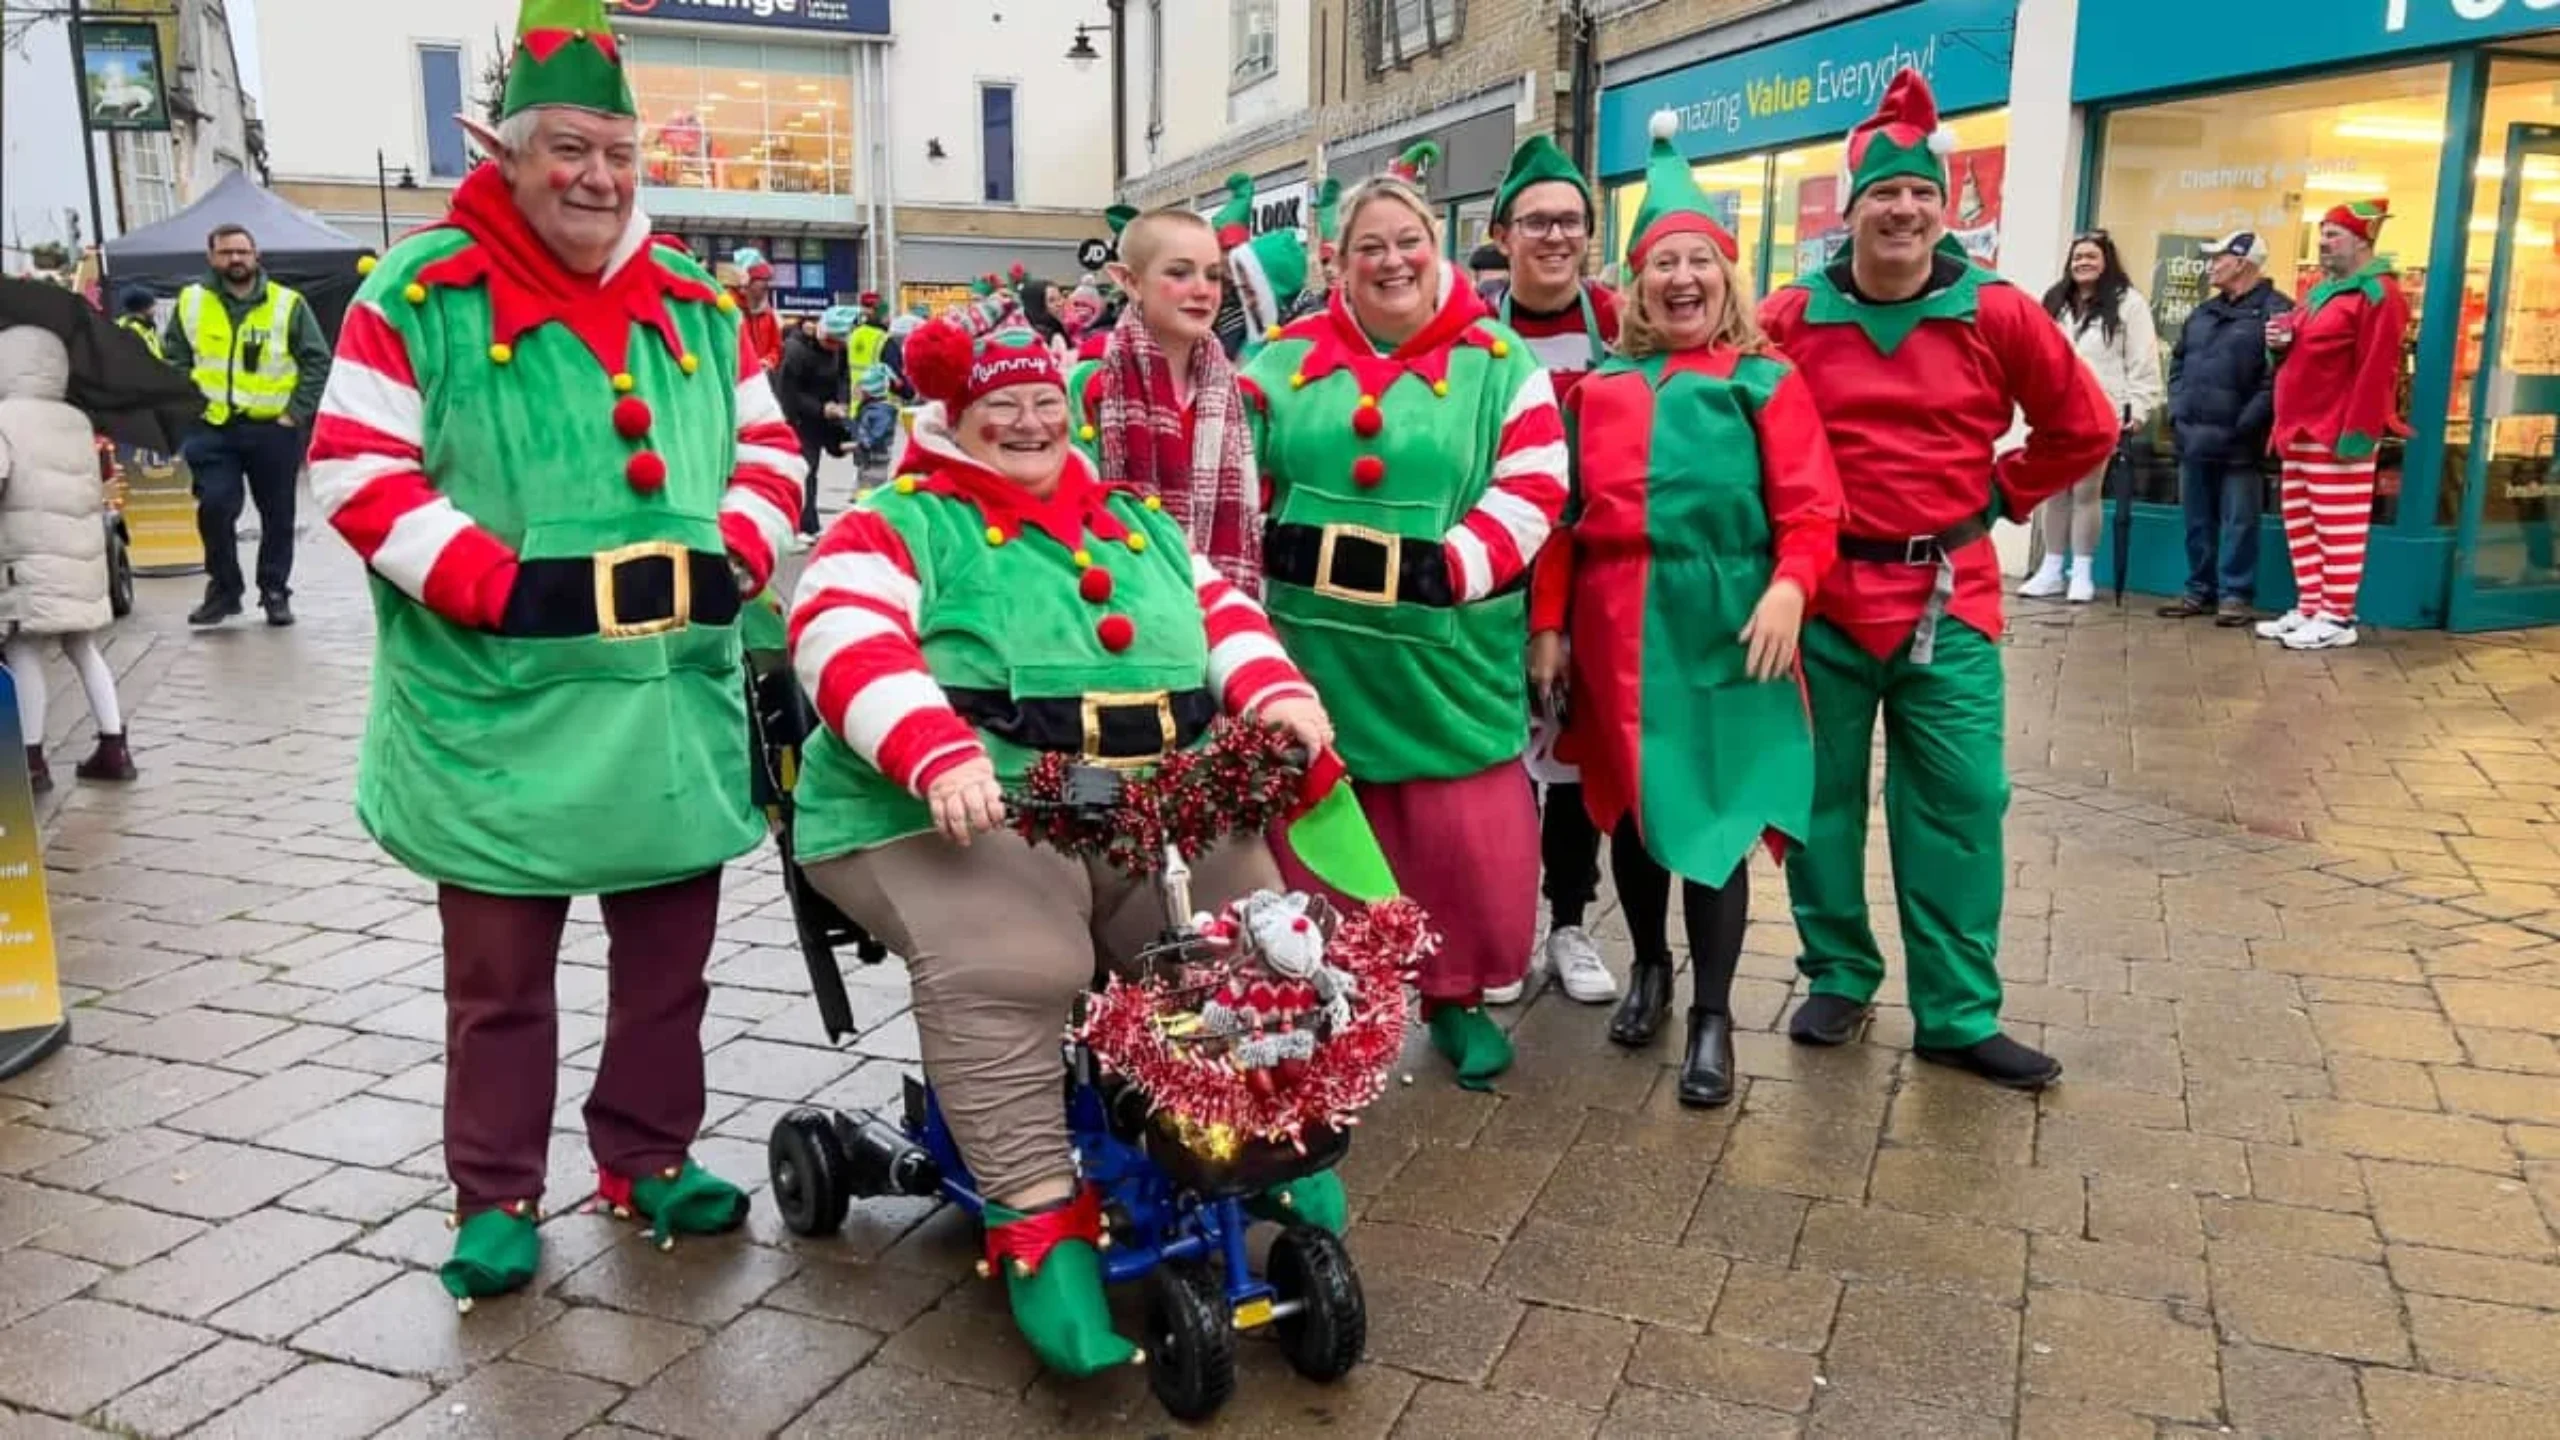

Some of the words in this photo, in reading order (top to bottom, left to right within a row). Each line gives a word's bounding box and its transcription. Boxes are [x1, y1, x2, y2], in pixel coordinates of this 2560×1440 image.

[1664, 90, 1741, 136] mazing
[1746, 73, 1811, 117] Value
[1252, 196, 1301, 236] LOOK
[1083, 244, 1106, 262] JD
